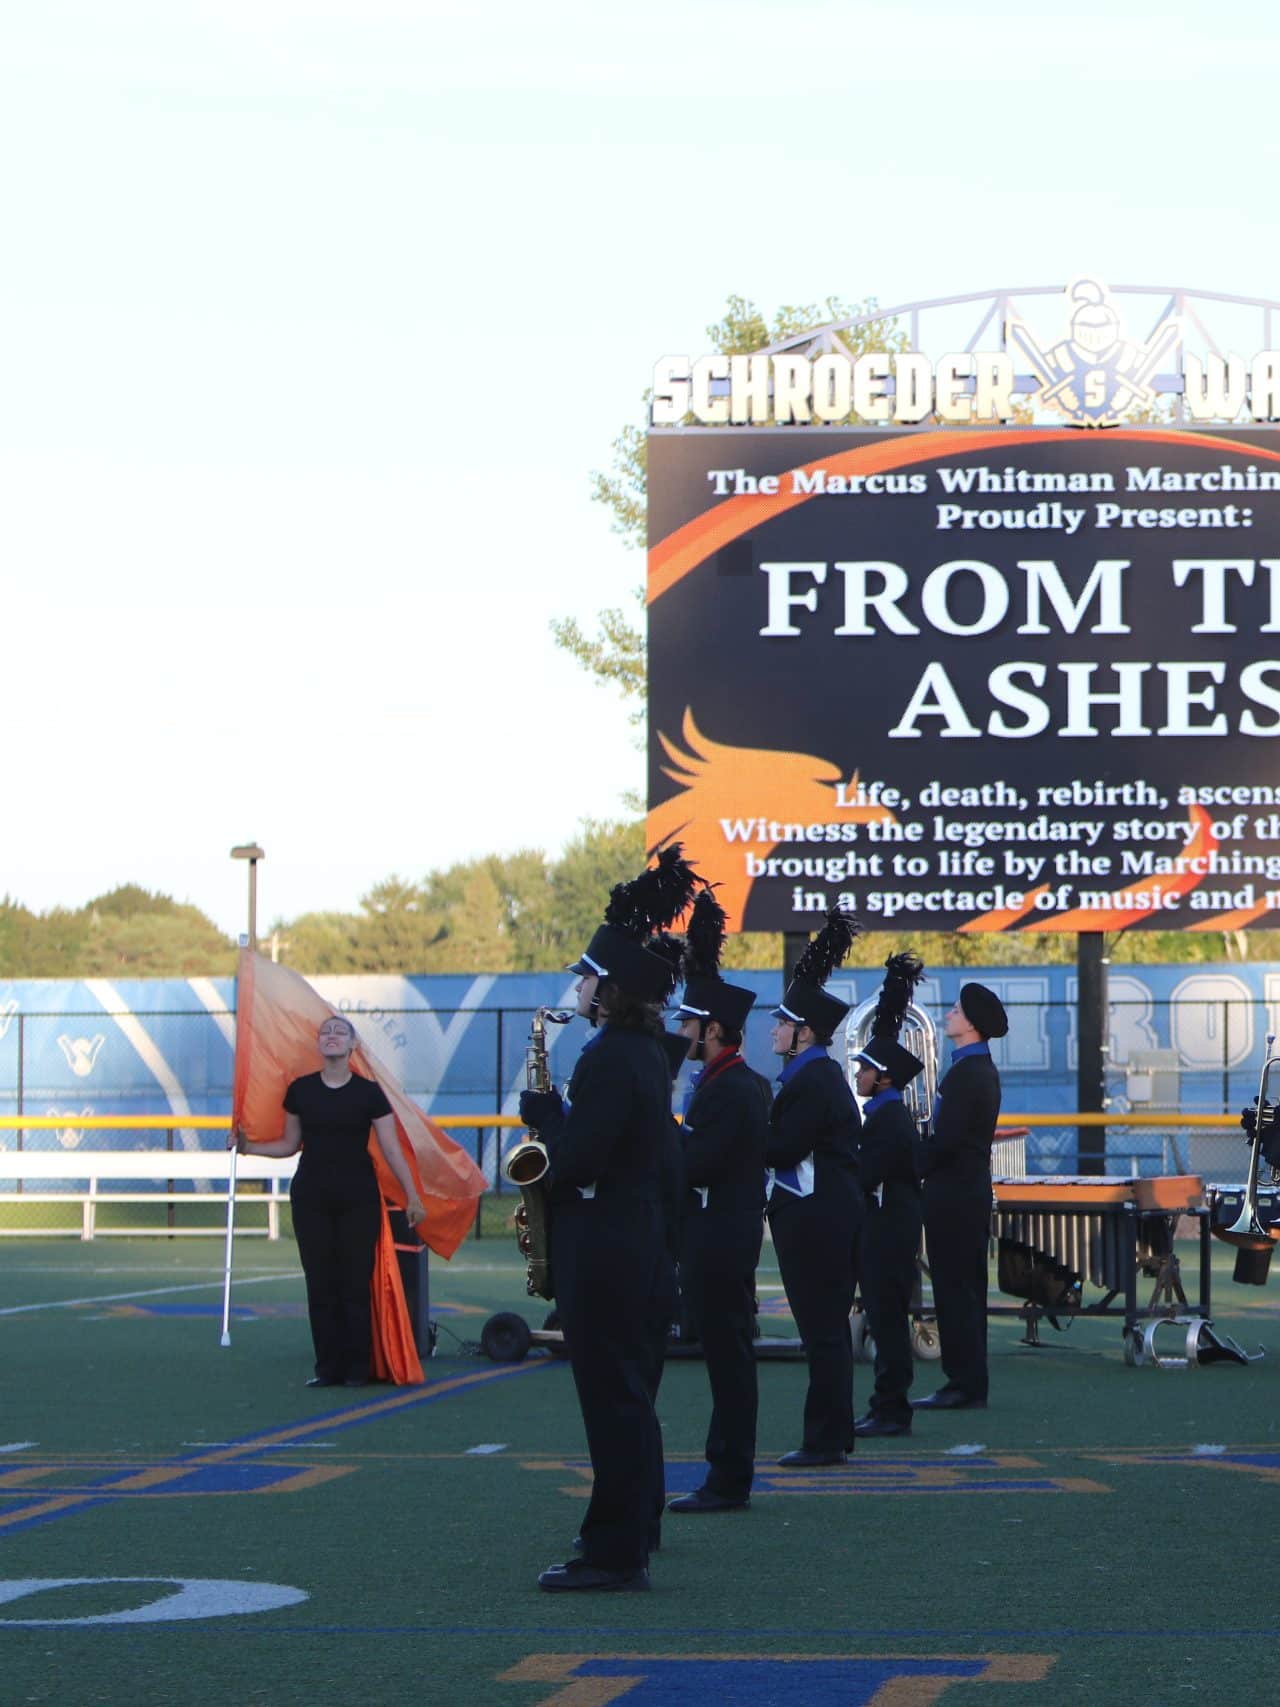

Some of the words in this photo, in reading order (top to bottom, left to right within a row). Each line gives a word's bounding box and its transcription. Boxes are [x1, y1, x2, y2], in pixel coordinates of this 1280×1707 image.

[652, 352, 1015, 424] SCHROEDER
[707, 468, 780, 495] The
[790, 469, 927, 494] Marcus
[937, 467, 1115, 493] Whitman
[937, 502, 1085, 534] Proudly
[1095, 503, 1252, 528] Present:
[759, 560, 1131, 636] FROM
[835, 782, 910, 811] Life,
[919, 781, 1028, 810] death,
[1037, 780, 1168, 809] rebirth,
[719, 817, 857, 843] Witness
[866, 816, 923, 842] the
[934, 815, 1104, 846] legendary
[1113, 819, 1201, 846] story
[1209, 814, 1248, 840] of
[745, 851, 882, 882] brought
[892, 854, 929, 876] to
[939, 850, 994, 876] life
[1004, 850, 1045, 881] by
[1054, 850, 1111, 875] the
[792, 886, 827, 912] in
[836, 892, 857, 912] a
[867, 885, 1025, 917] spectacle
[1034, 885, 1073, 910] of
[1079, 885, 1181, 910] music
[1189, 884, 1255, 910] and
